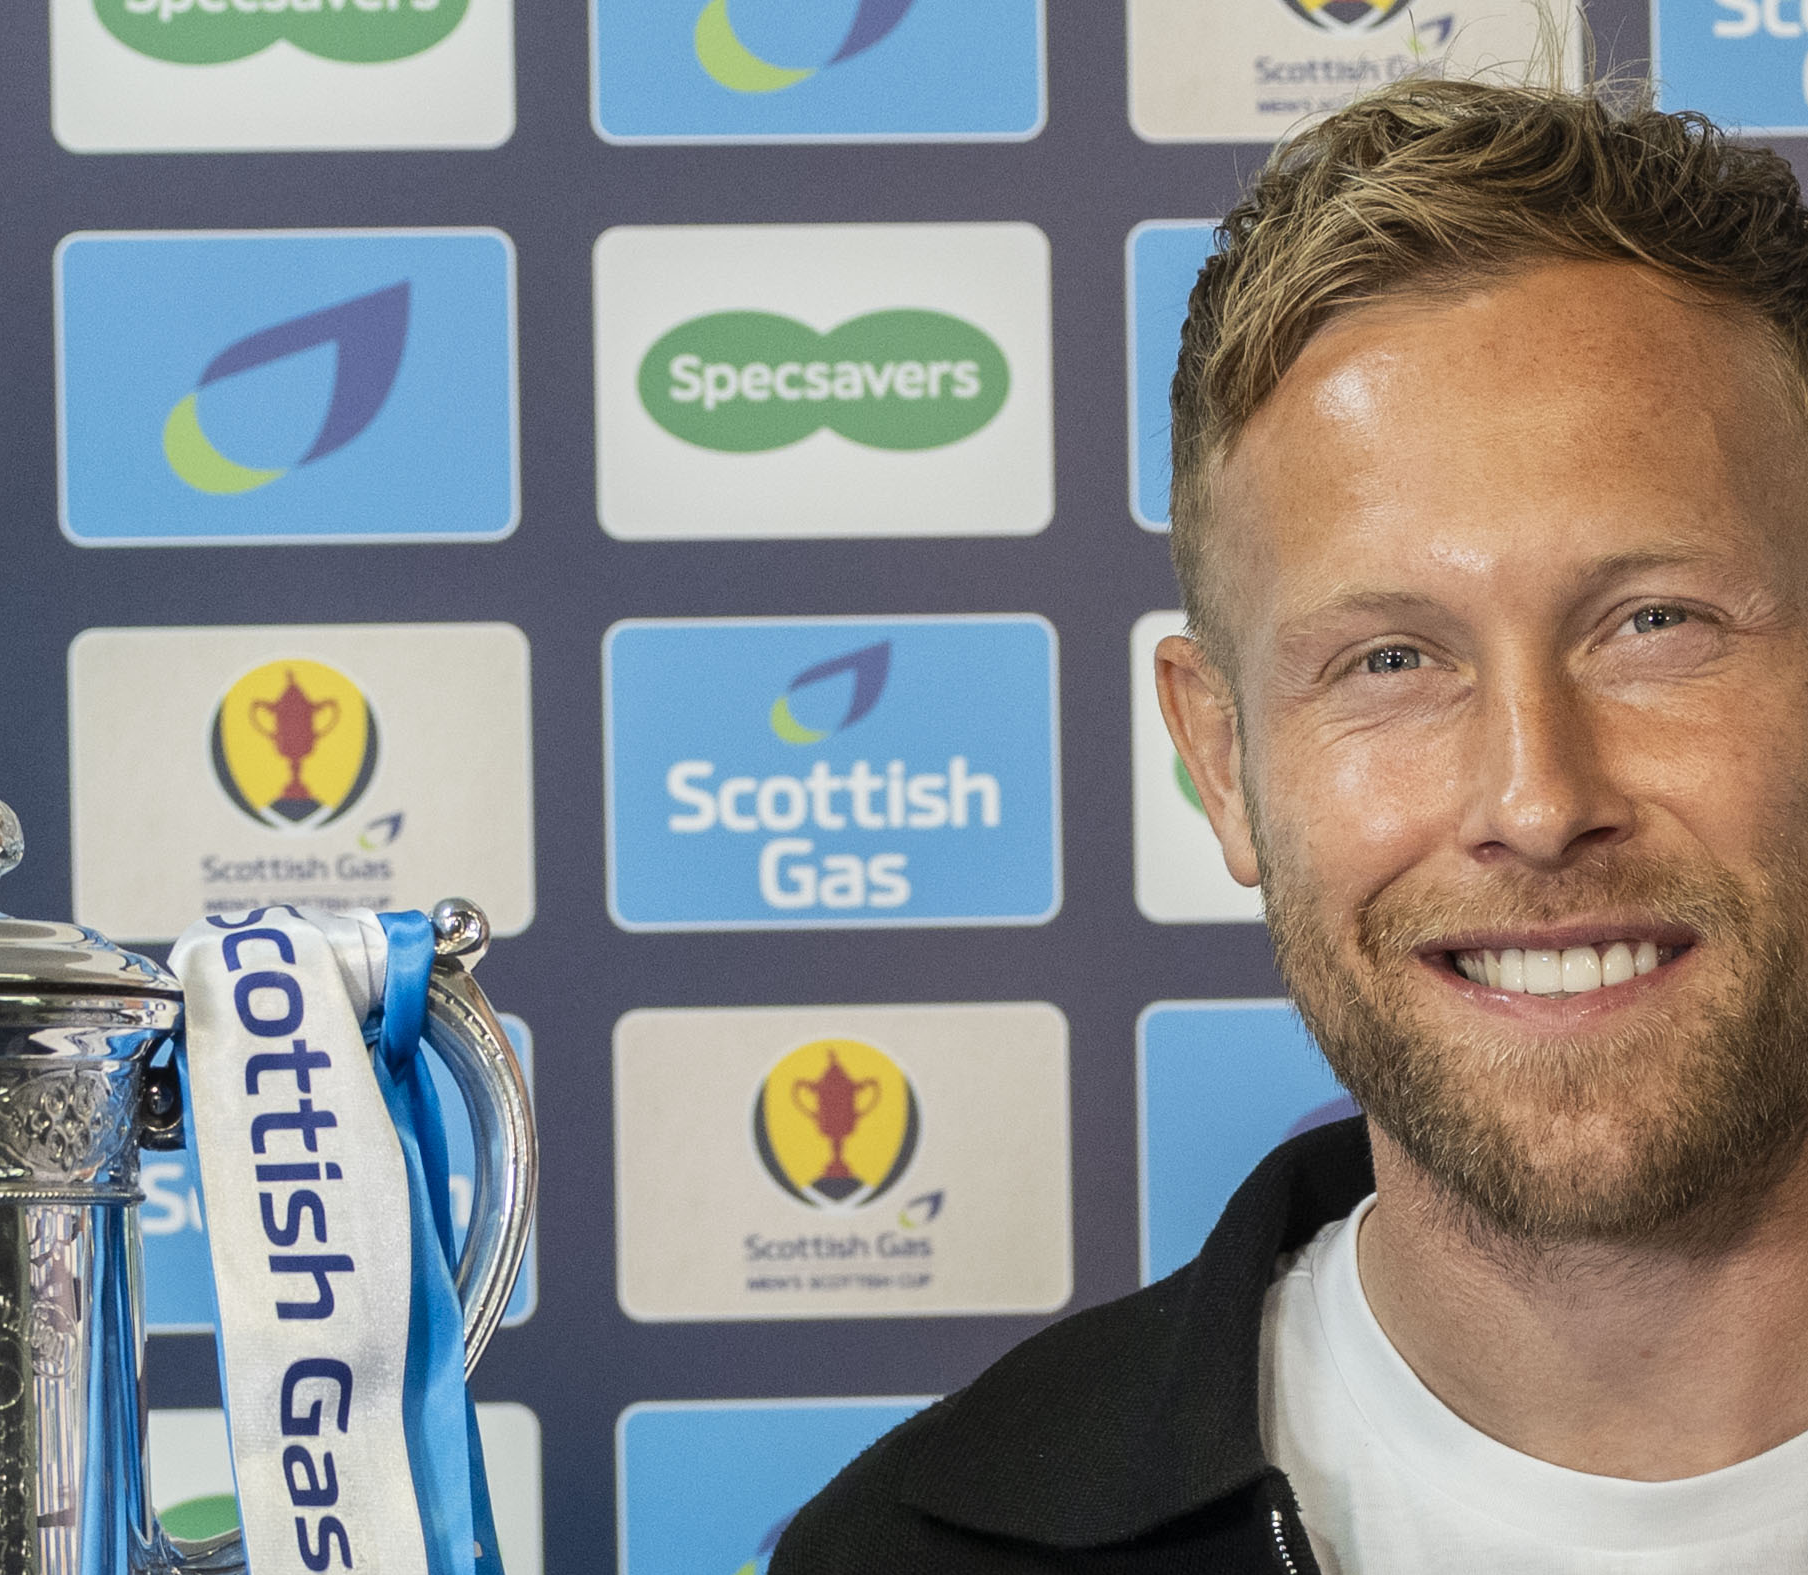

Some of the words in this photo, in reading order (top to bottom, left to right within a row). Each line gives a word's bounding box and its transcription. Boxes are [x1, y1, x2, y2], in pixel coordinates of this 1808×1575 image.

[1254, 56, 1380, 85] Scottish
[669, 354, 981, 411] Specsavers
[666, 756, 1001, 833] Scottish
[200, 855, 330, 884] Scottish
[335, 854, 394, 881] Gas
[759, 837, 911, 909] Gas
[205, 905, 355, 1322] Scottish
[280, 1357, 354, 1573] Gas
[743, 1234, 871, 1262] Scottish
[876, 1232, 934, 1259] Gas
[897, 1272, 933, 1289] CUP
